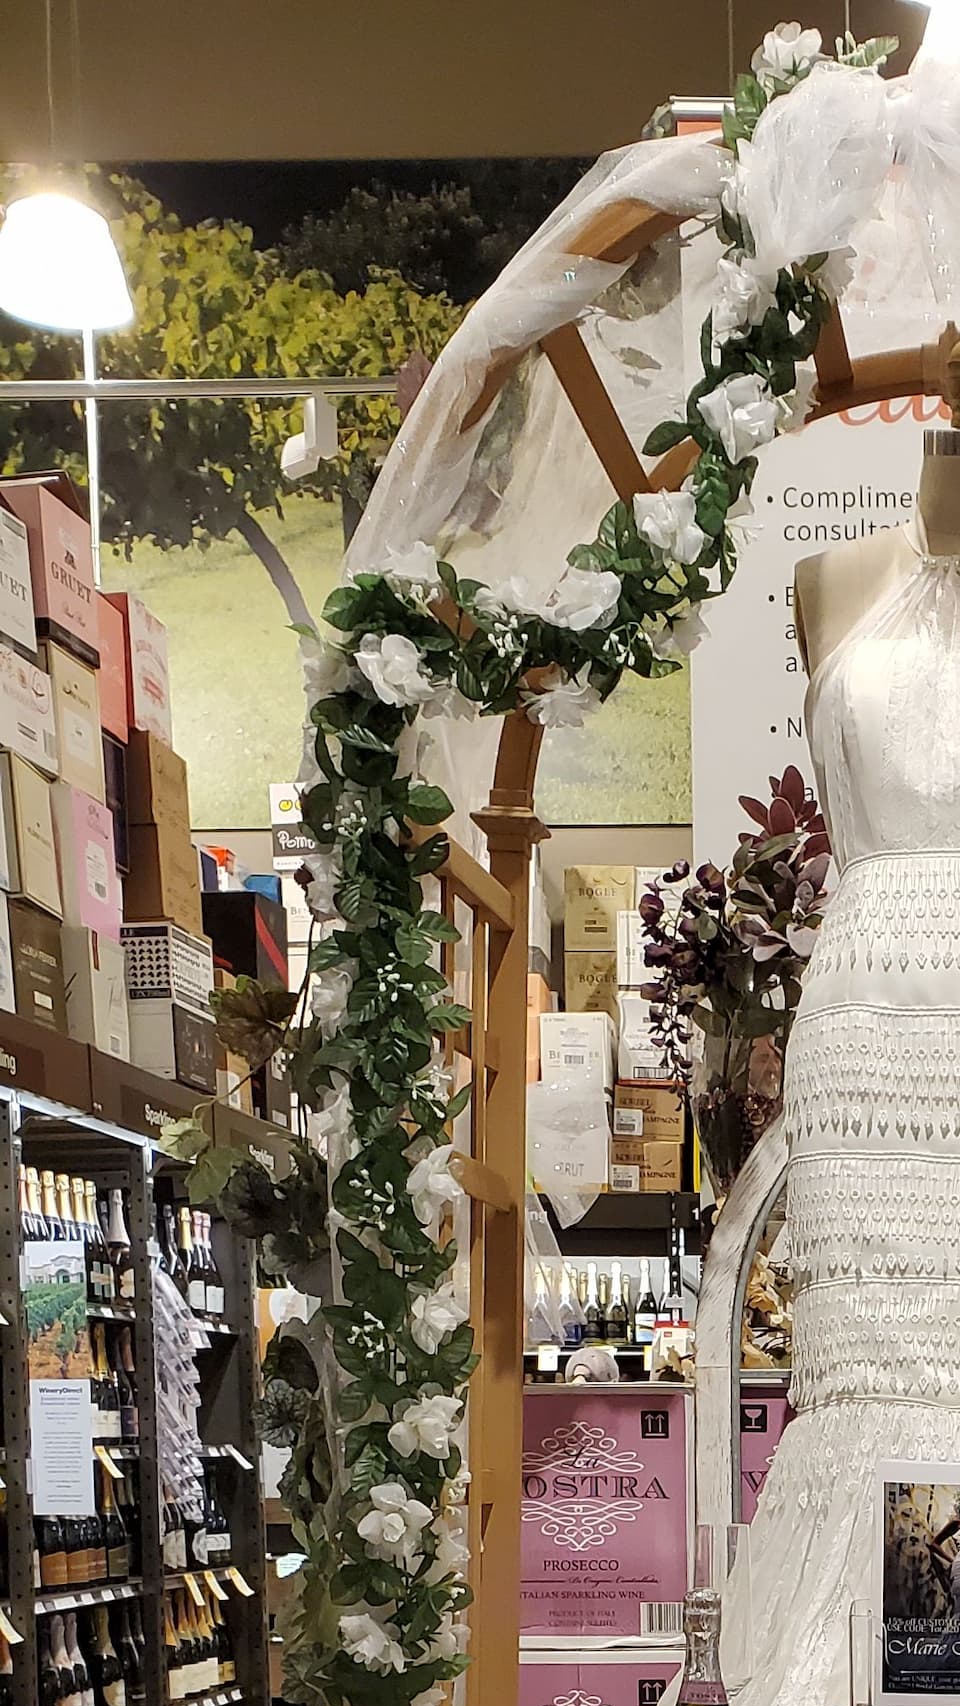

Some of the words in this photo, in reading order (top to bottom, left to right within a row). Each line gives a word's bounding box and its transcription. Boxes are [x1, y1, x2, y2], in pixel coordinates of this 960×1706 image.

[783, 485, 918, 514] Complime
[784, 518, 909, 541] consult
[51, 561, 91, 603] GRUET
[578, 888, 617, 897] BOGLE
[562, 1444, 600, 1468] La
[522, 1475, 670, 1499] OSTRA
[543, 1559, 620, 1571] PROSECCO
[561, 1591, 616, 1599] SPARKLING
[618, 1591, 645, 1599] WINE
[888, 1637, 948, 1656] Marie
